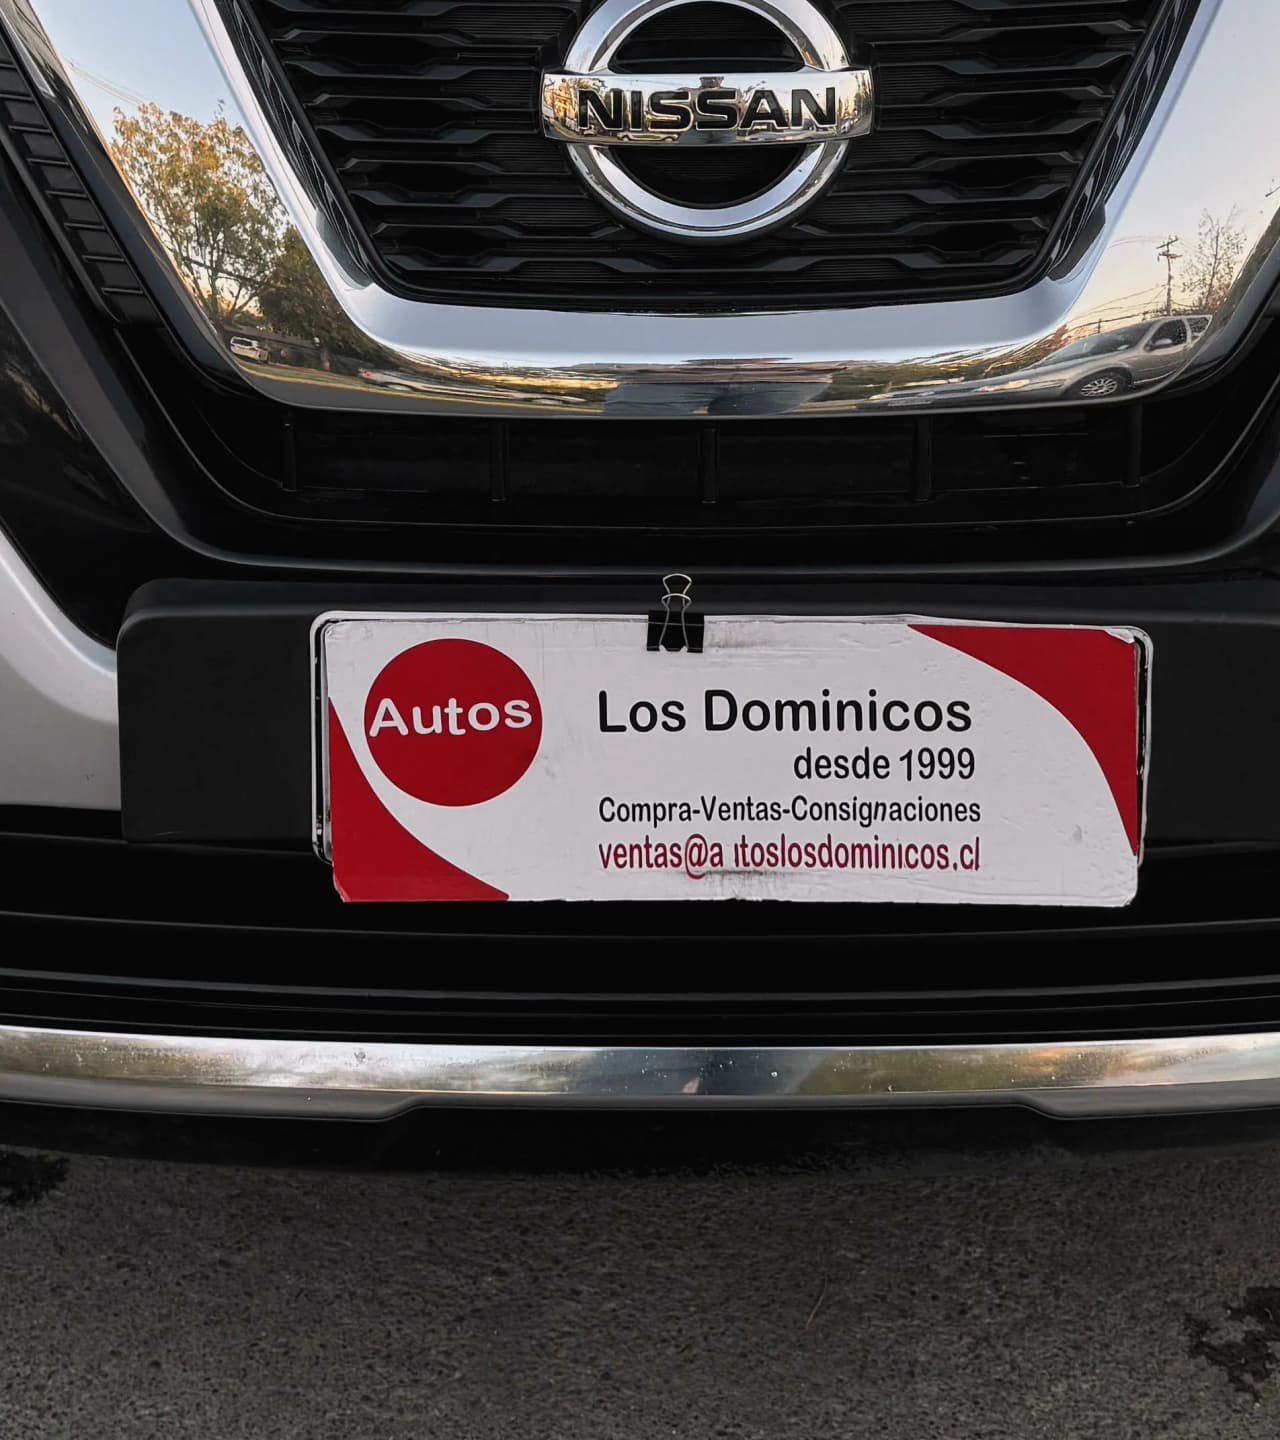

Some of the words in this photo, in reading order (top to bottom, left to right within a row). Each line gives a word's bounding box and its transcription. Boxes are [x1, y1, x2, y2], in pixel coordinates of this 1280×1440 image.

[577, 86, 837, 131] NISSAN
[369, 697, 533, 738] Autos
[598, 690, 686, 733] Los
[704, 688, 972, 733] Dominicos
[793, 746, 891, 780] desde
[899, 747, 975, 782] 1999
[598, 795, 981, 829] Compra-Ventas-Consignaciones
